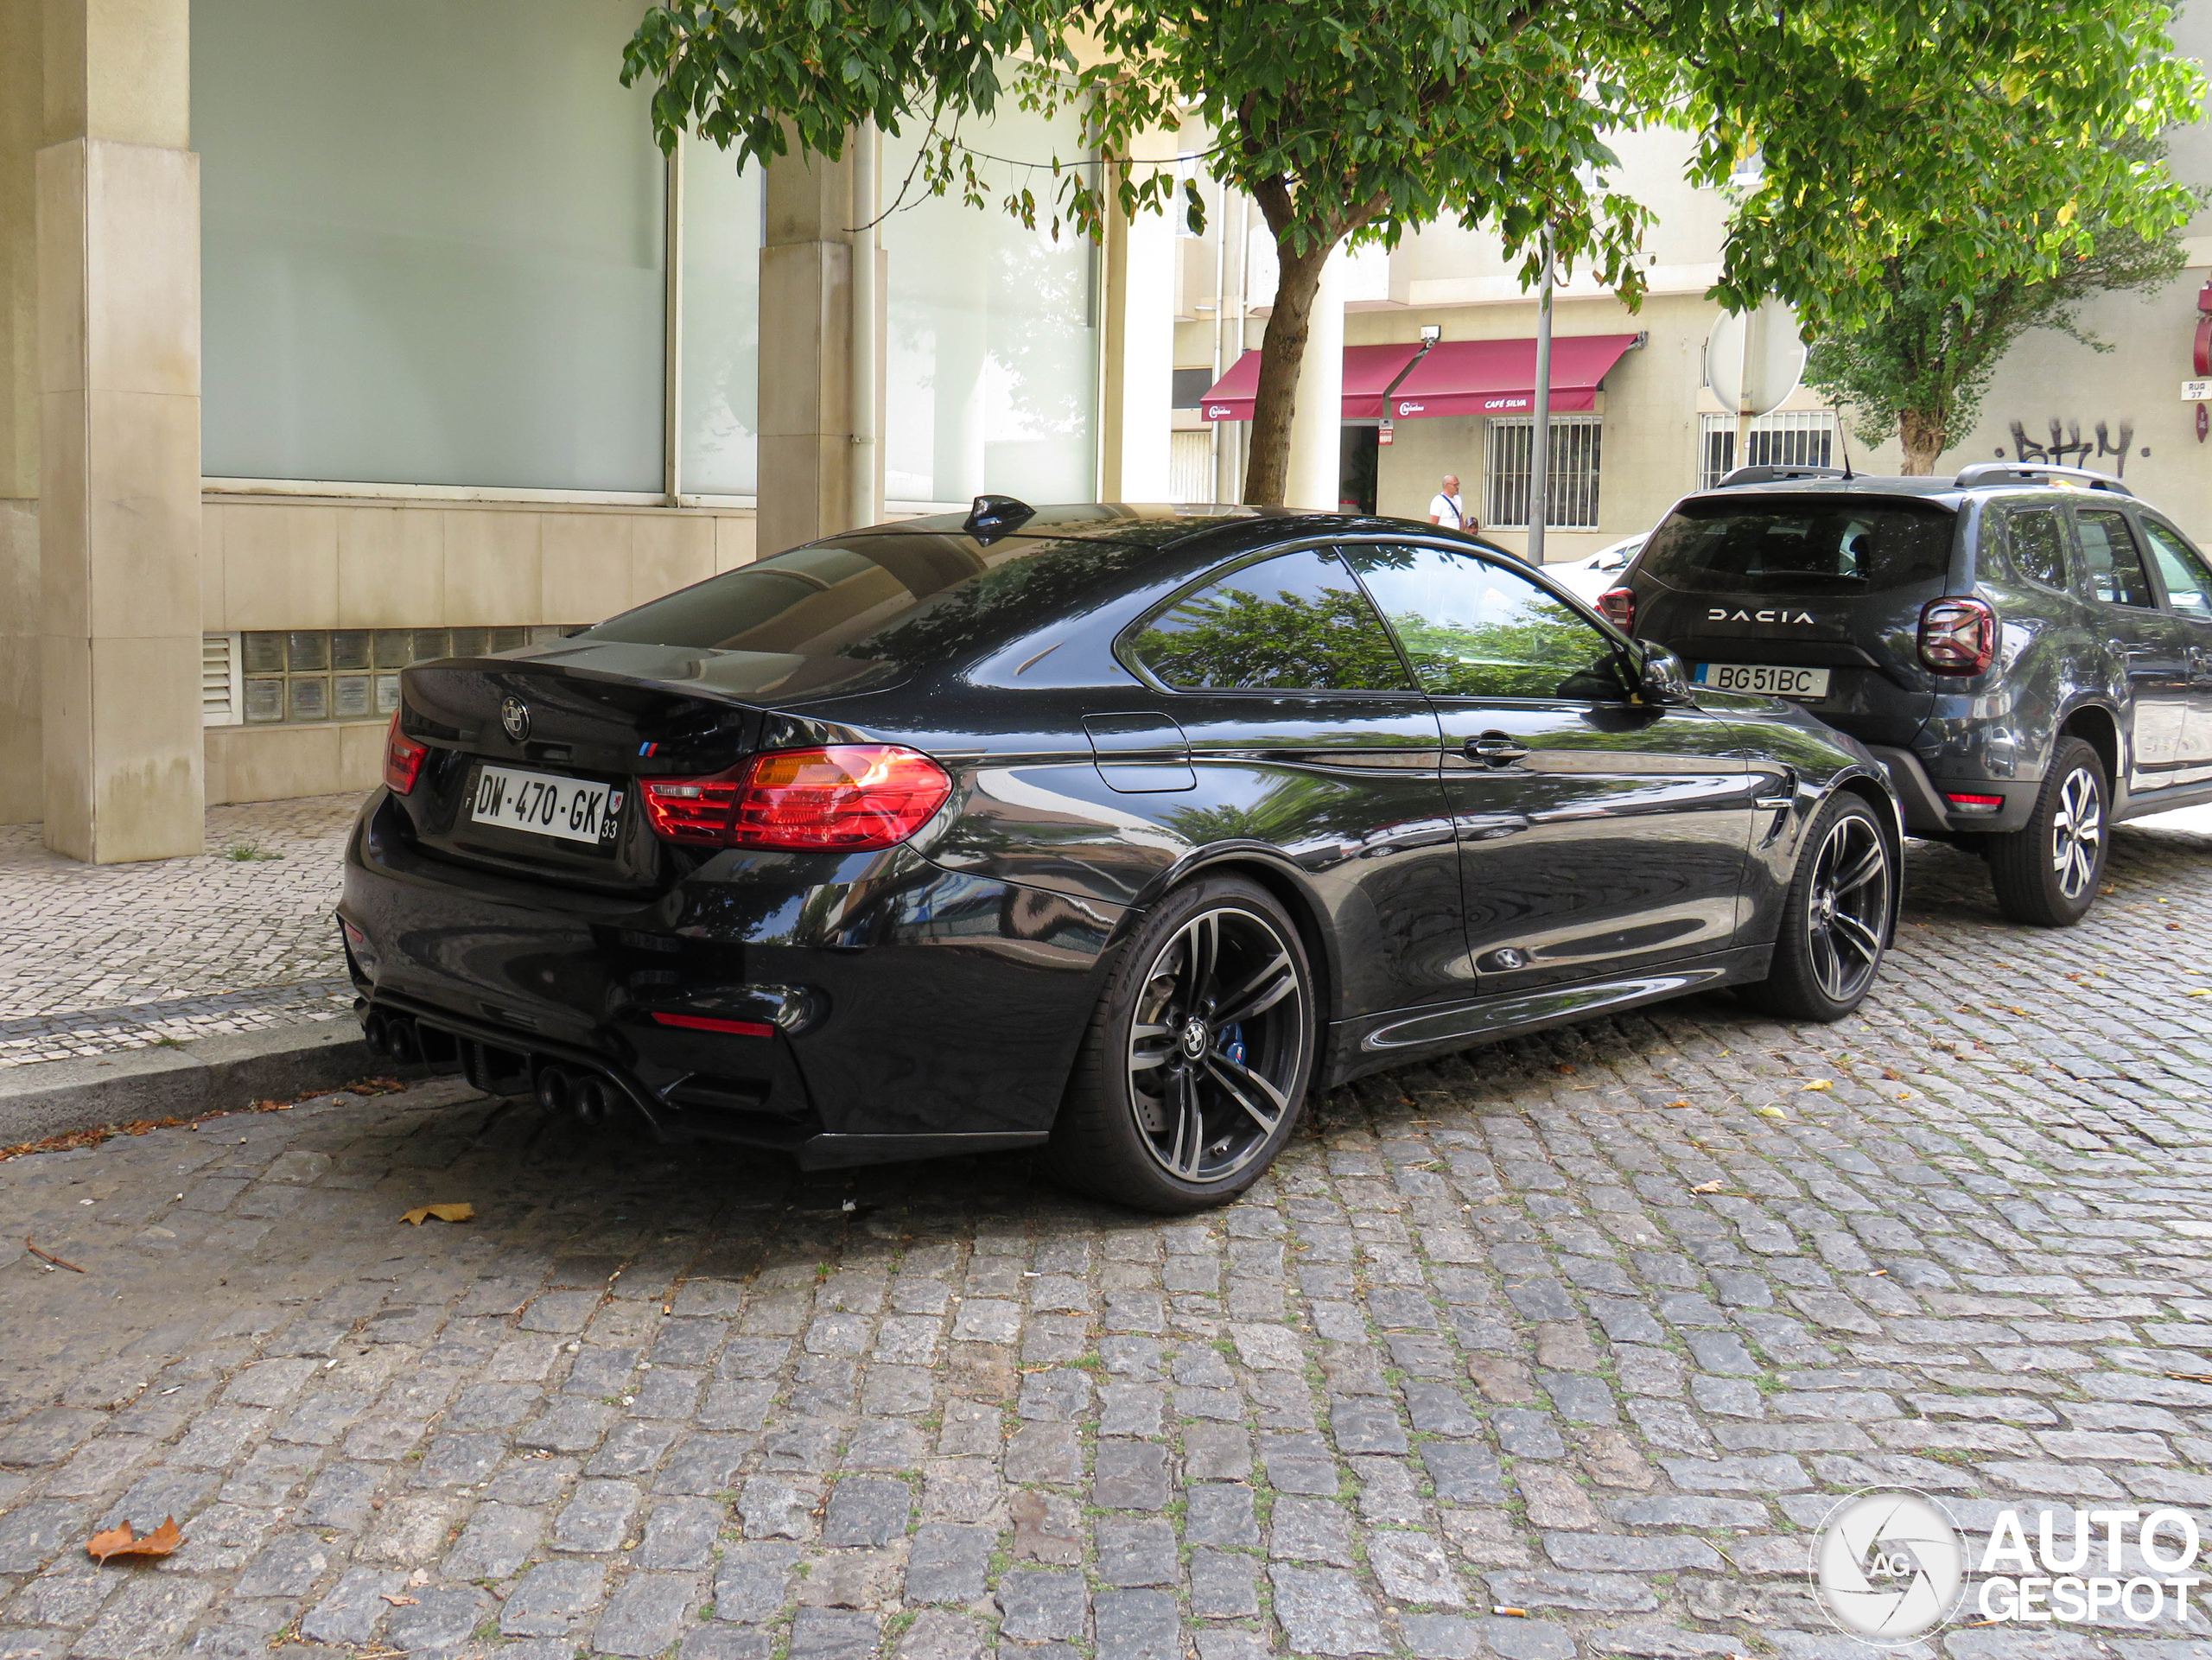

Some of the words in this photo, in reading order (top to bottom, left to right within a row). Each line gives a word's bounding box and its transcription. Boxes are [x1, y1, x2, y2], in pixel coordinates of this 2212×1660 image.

[1484, 398, 1505, 410] CAFÉ
[1505, 398, 1527, 408] SILVA
[1707, 608, 1815, 625] DACIA
[601, 819, 618, 839] 33
